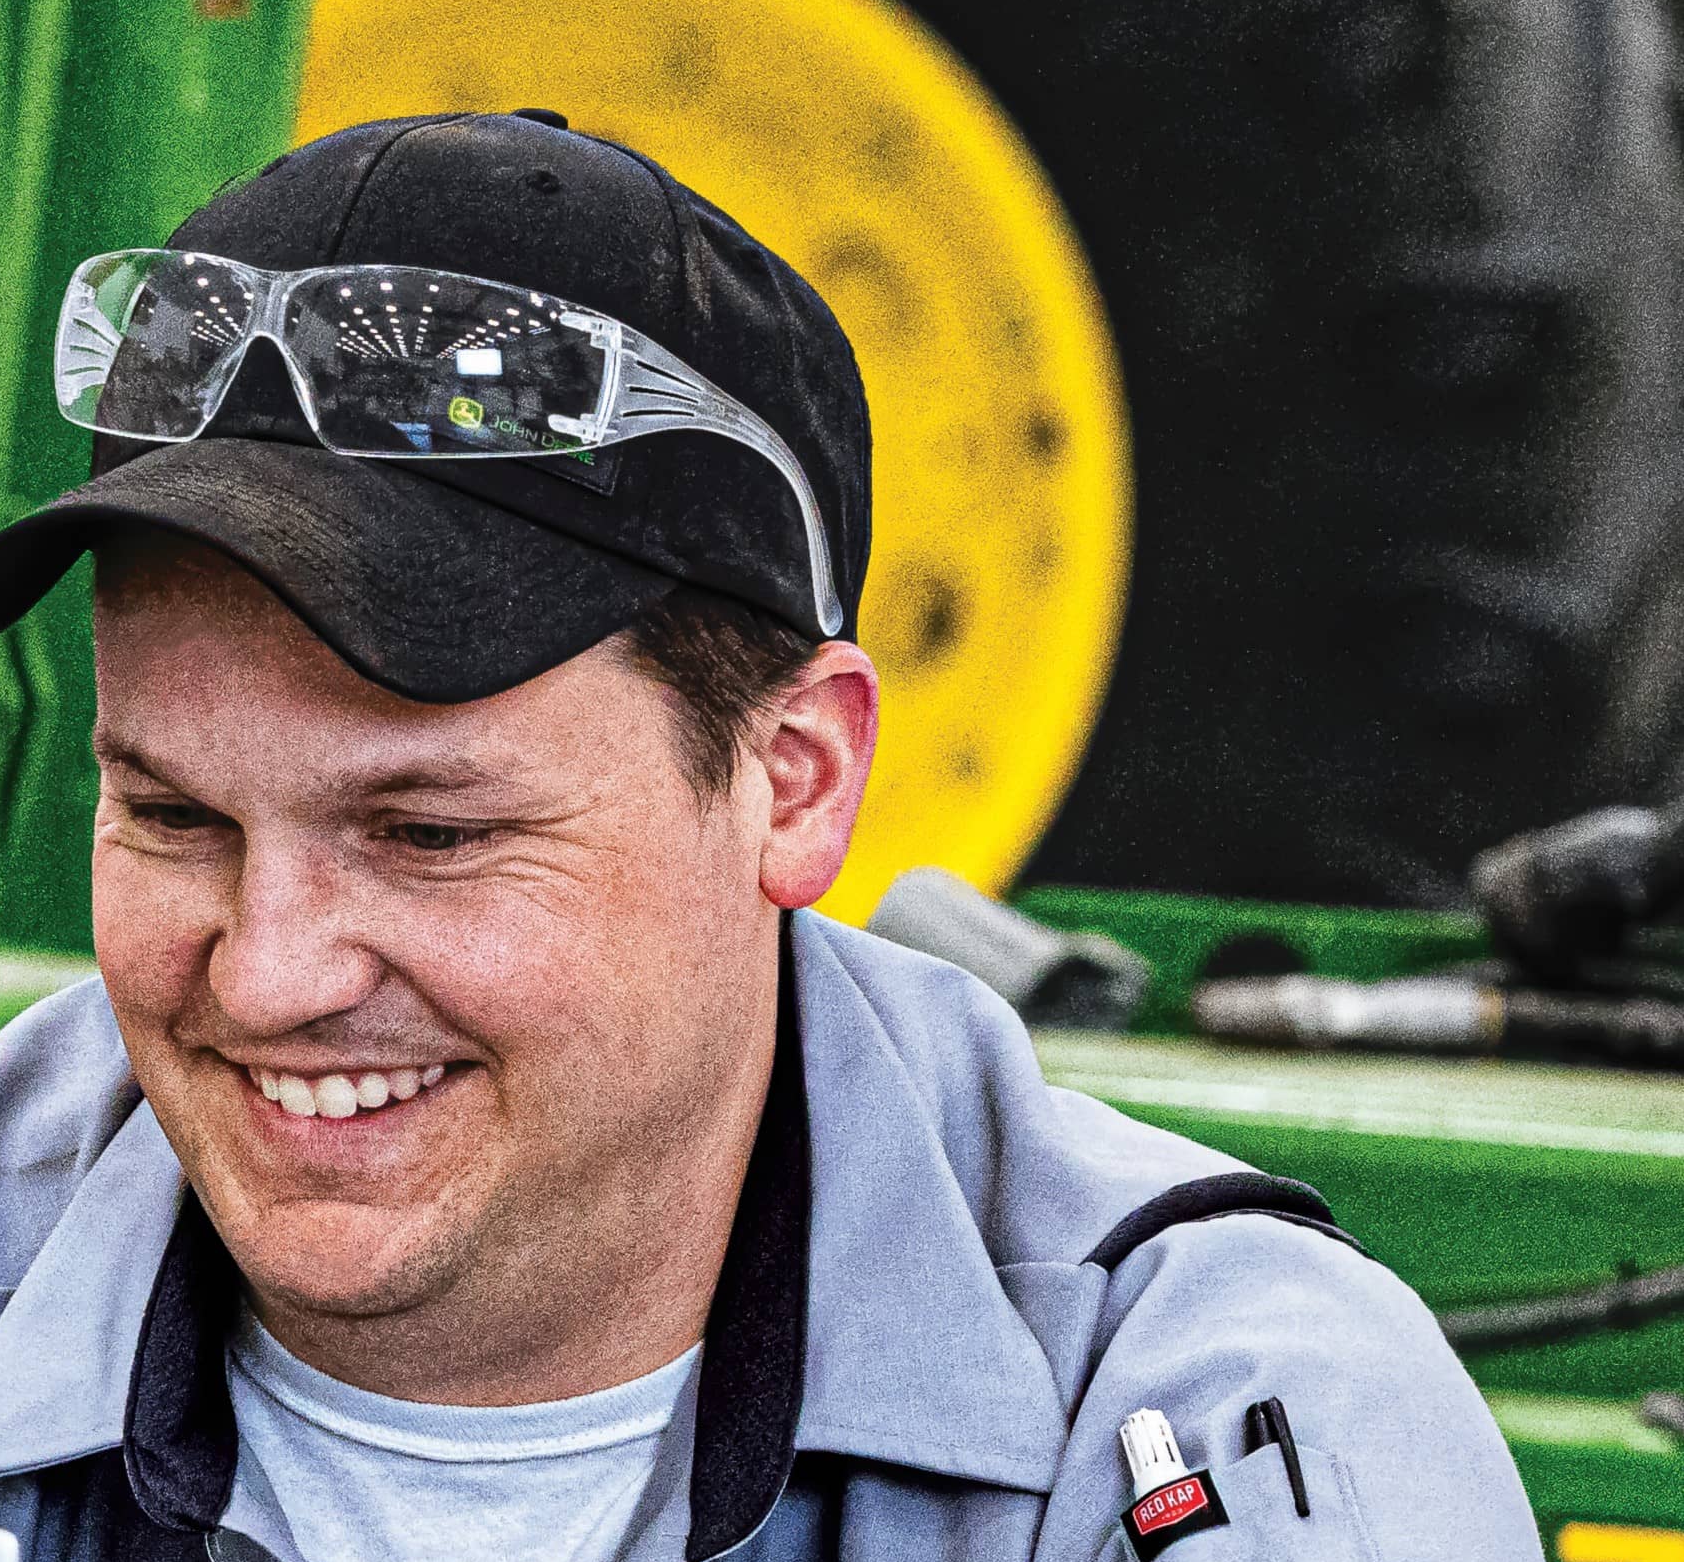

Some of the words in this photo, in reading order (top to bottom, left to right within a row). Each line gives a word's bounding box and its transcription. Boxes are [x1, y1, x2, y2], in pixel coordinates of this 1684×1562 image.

[491, 415, 538, 441] JOHN
[1139, 1498, 1165, 1523] RED
[1166, 1485, 1194, 1508] KAP
